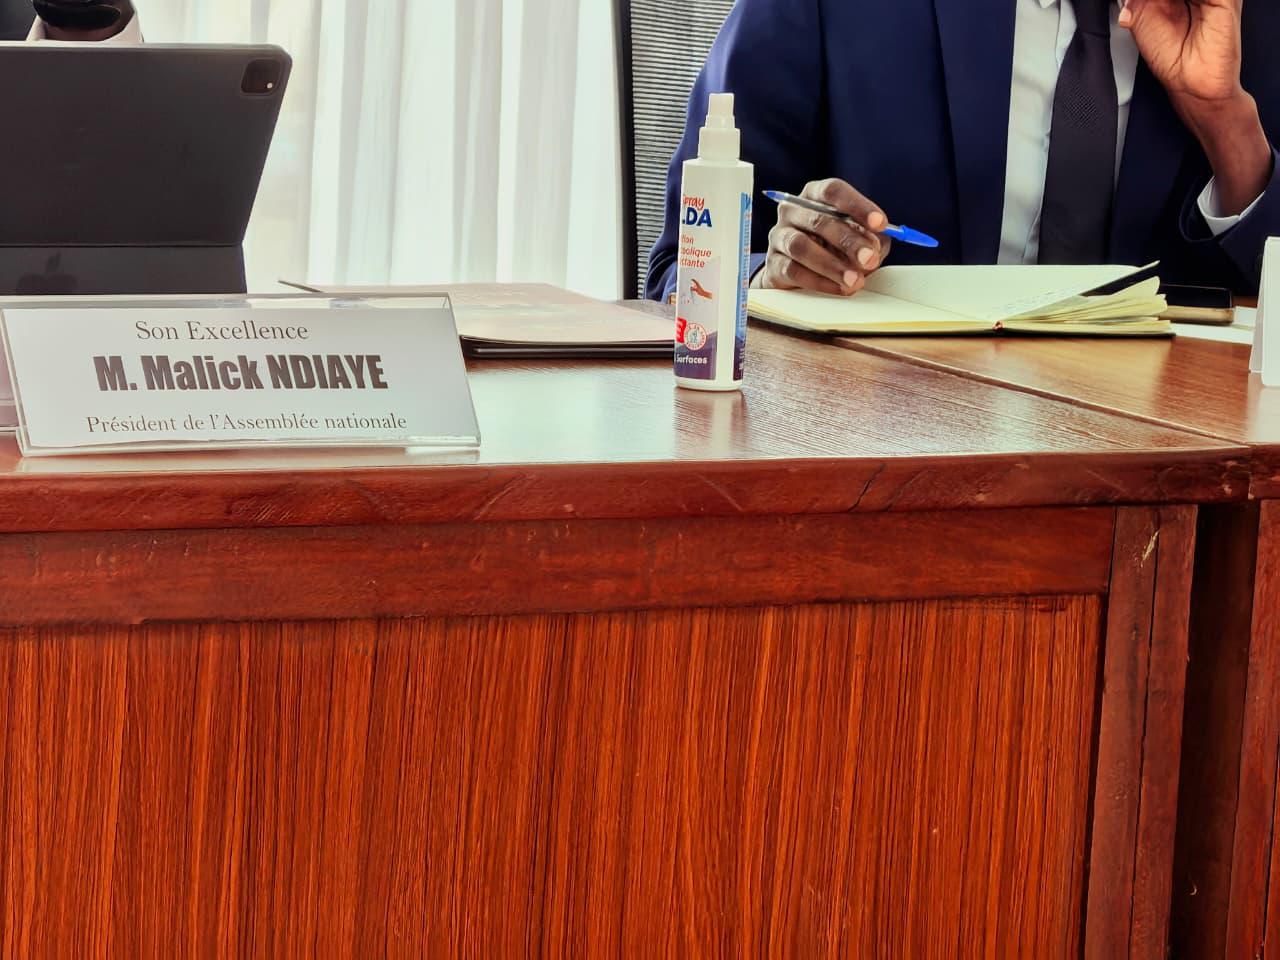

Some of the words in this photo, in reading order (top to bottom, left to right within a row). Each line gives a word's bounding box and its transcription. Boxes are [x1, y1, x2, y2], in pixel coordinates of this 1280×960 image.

[682, 207, 712, 227] DA
[135, 320, 179, 340] Son
[186, 320, 309, 340] Excellence
[93, 356, 138, 391] M.
[140, 355, 264, 391] Malick
[266, 354, 389, 390] NDIAYE
[86, 415, 177, 433] Président
[183, 415, 204, 431] de
[209, 413, 319, 431] l'Assemblée
[324, 413, 407, 429] nationale
